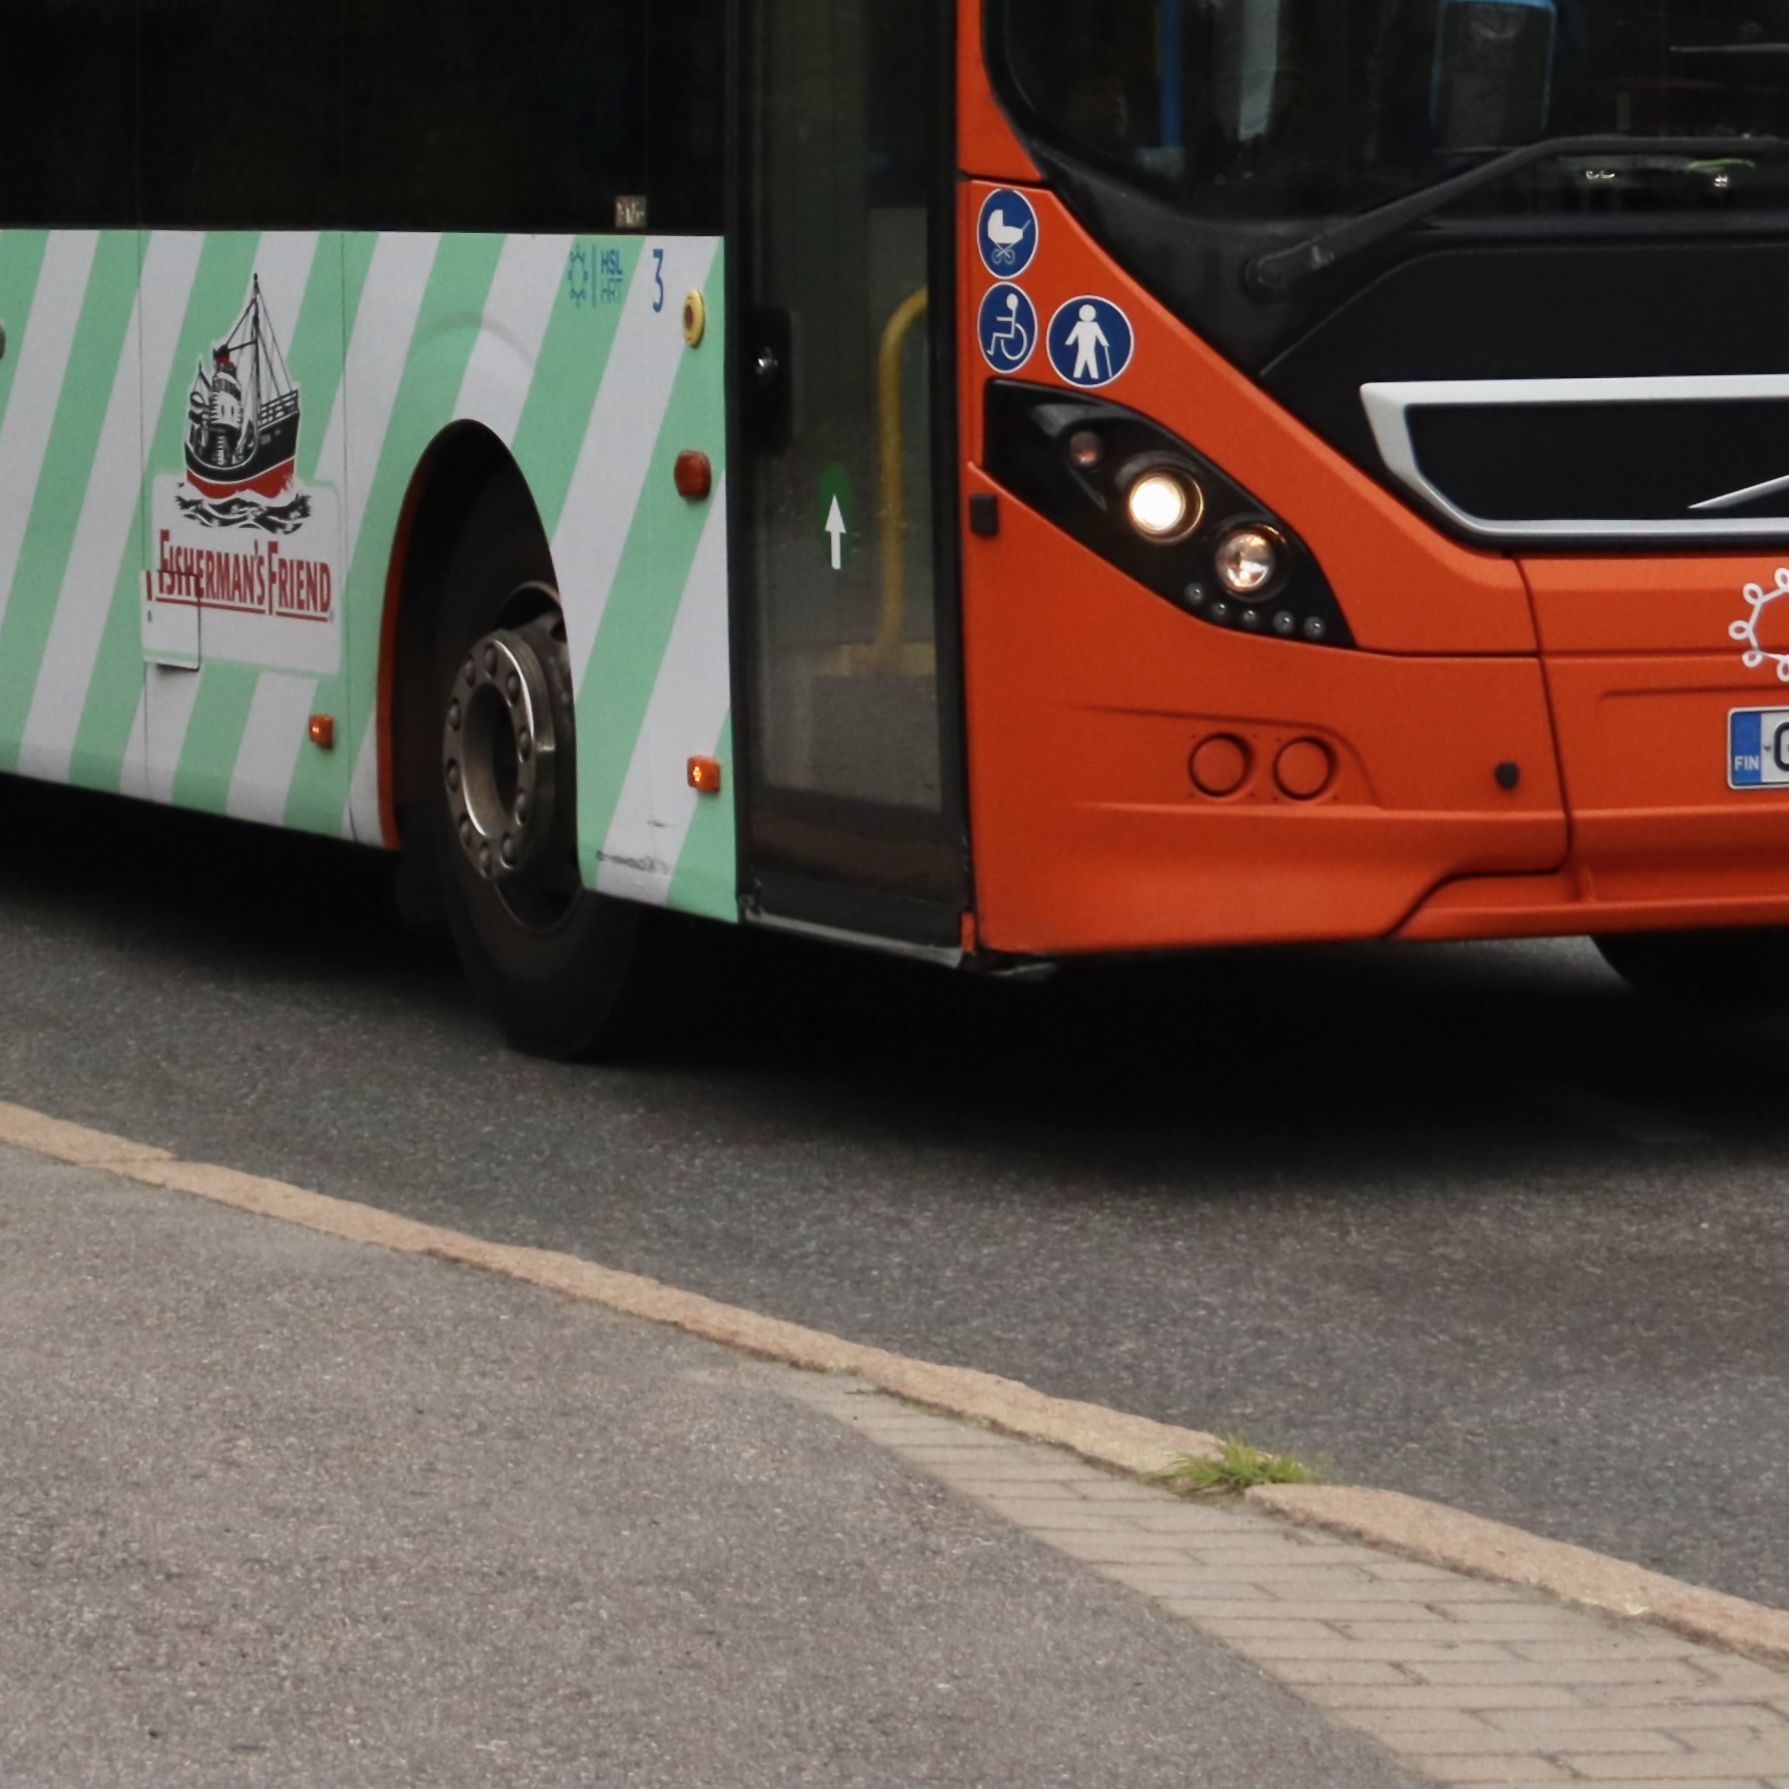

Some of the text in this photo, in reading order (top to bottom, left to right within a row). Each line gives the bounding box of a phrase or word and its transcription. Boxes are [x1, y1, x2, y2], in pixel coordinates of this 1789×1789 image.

[652, 248, 664, 313] 3
[158, 529, 332, 615] FISHERMAN'S FRIEND
[1734, 755, 1759, 771] FIN
